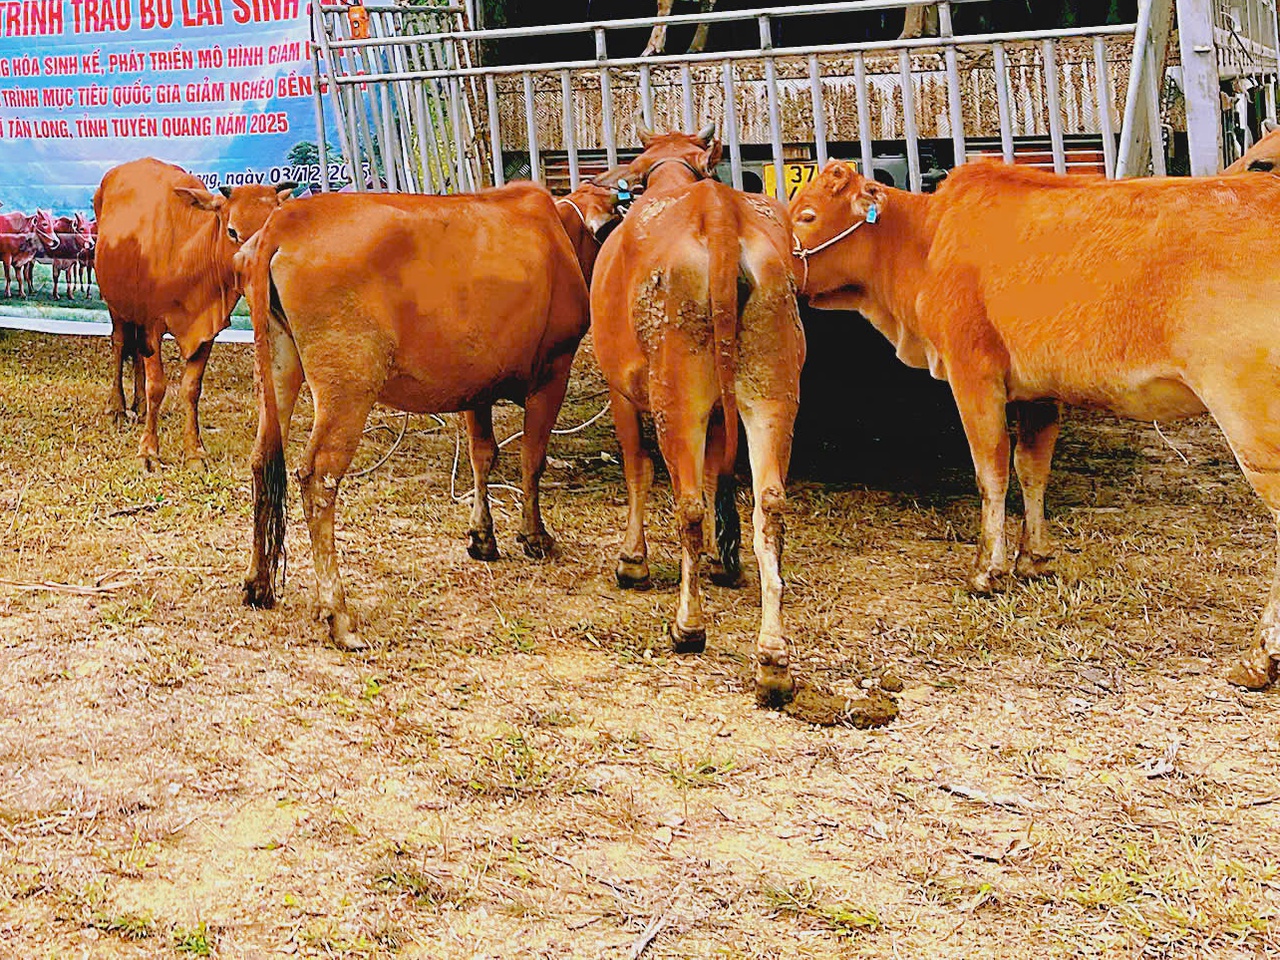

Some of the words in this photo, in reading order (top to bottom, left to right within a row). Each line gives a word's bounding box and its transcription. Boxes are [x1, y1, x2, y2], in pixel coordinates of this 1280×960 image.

[12, 54, 40, 76] HÓA
[44, 56, 78, 75] SINH
[82, 49, 104, 75] KẾ,
[108, 49, 145, 72] PHÁT
[149, 43, 193, 71] TRIỂN
[197, 45, 223, 68] MÔ
[227, 44, 264, 67] HÌNH
[1, 86, 39, 107] TRÌNH
[42, 88, 73, 111] MỤC
[77, 83, 108, 106] TIÊU
[112, 79, 151, 107] QUỐC
[156, 84, 181, 104] GIA
[185, 77, 225, 102] GIẢM
[230, 77, 274, 101] NGHÈO
[277, 70, 313, 97] BỀN
[8, 116, 32, 138] TÂN
[33, 120, 74, 139] LONG,
[75, 113, 108, 138] TỈNH
[111, 114, 157, 137] TUYÊN
[162, 116, 211, 138] QUANG
[215, 111, 247, 136] NĂM
[249, 112, 288, 134] 2025
[188, 170, 221, 189] ng,
